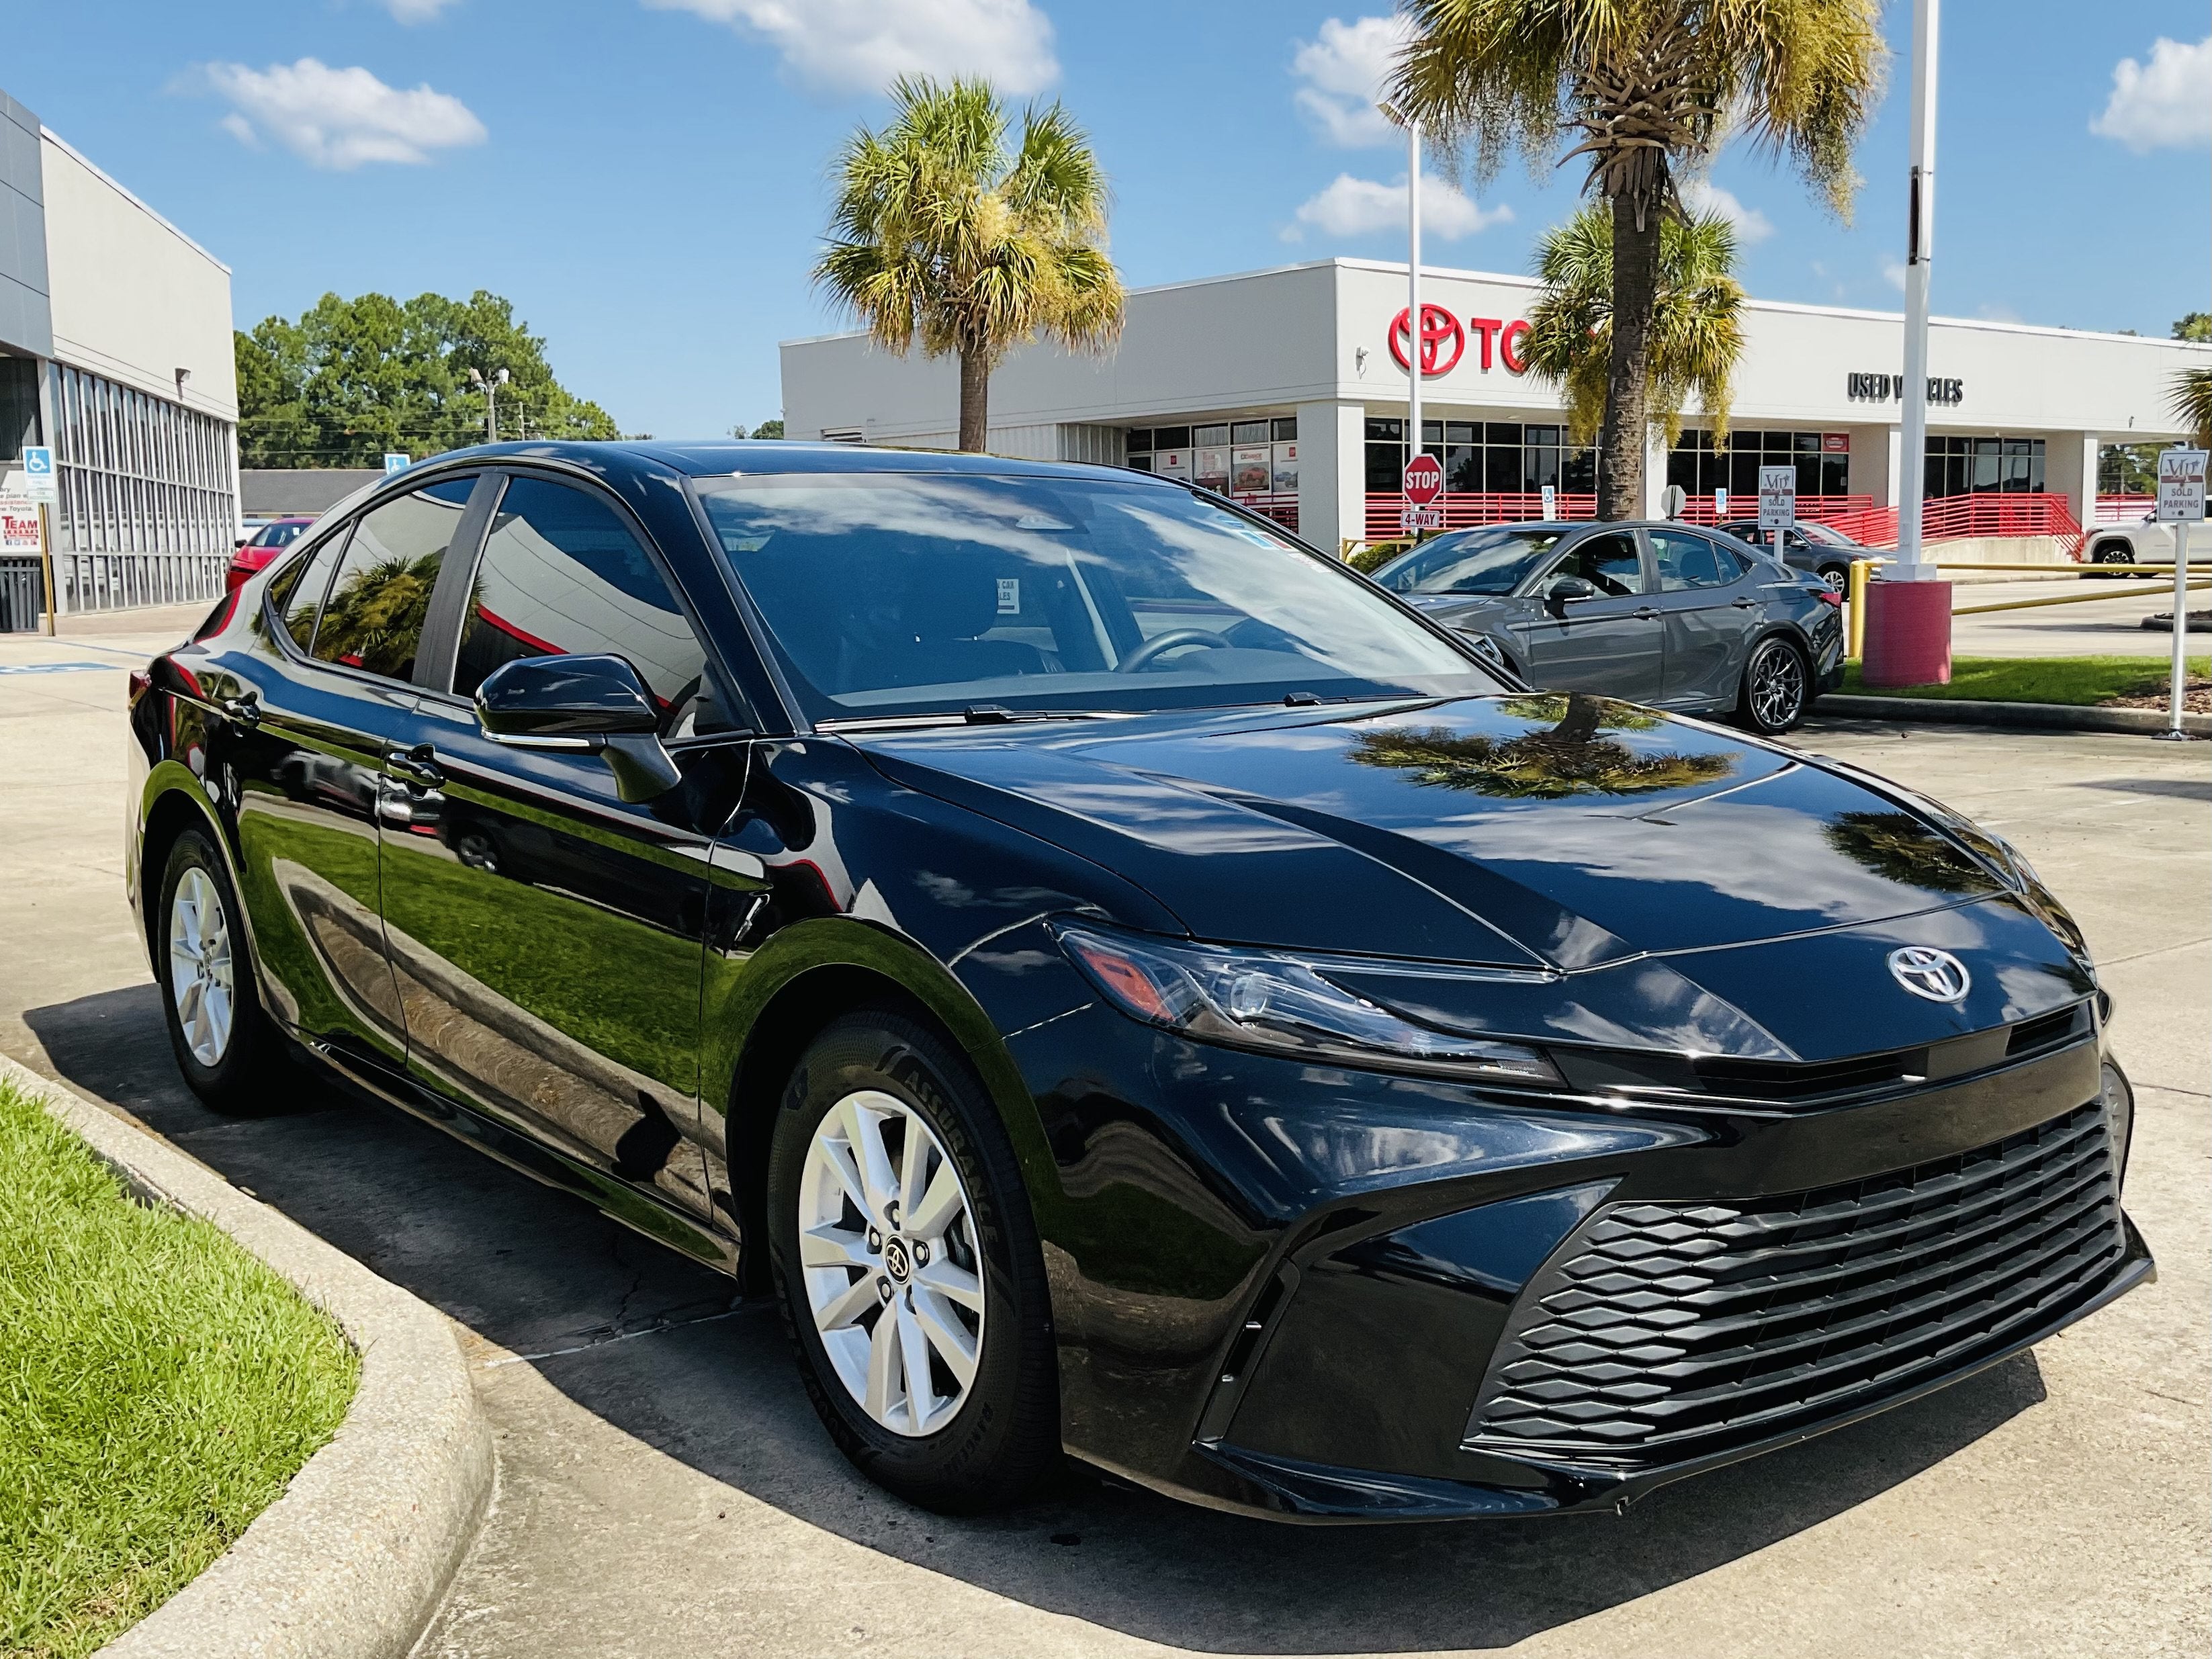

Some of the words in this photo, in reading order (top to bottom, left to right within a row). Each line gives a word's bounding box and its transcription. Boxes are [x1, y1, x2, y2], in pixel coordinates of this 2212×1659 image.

[1848, 373, 1890, 398] USED
[1892, 375, 1963, 402] VCLES
[1405, 472, 1440, 489] STOP
[2171, 488, 2193, 496] SOLD
[2163, 500, 2199, 508] PARKING
[1763, 508, 1789, 517] PARKING
[1, 516, 38, 529] TEAM
[1405, 514, 1435, 525] 4-WAY
[903, 1069, 1000, 1243] ASSURANCE
